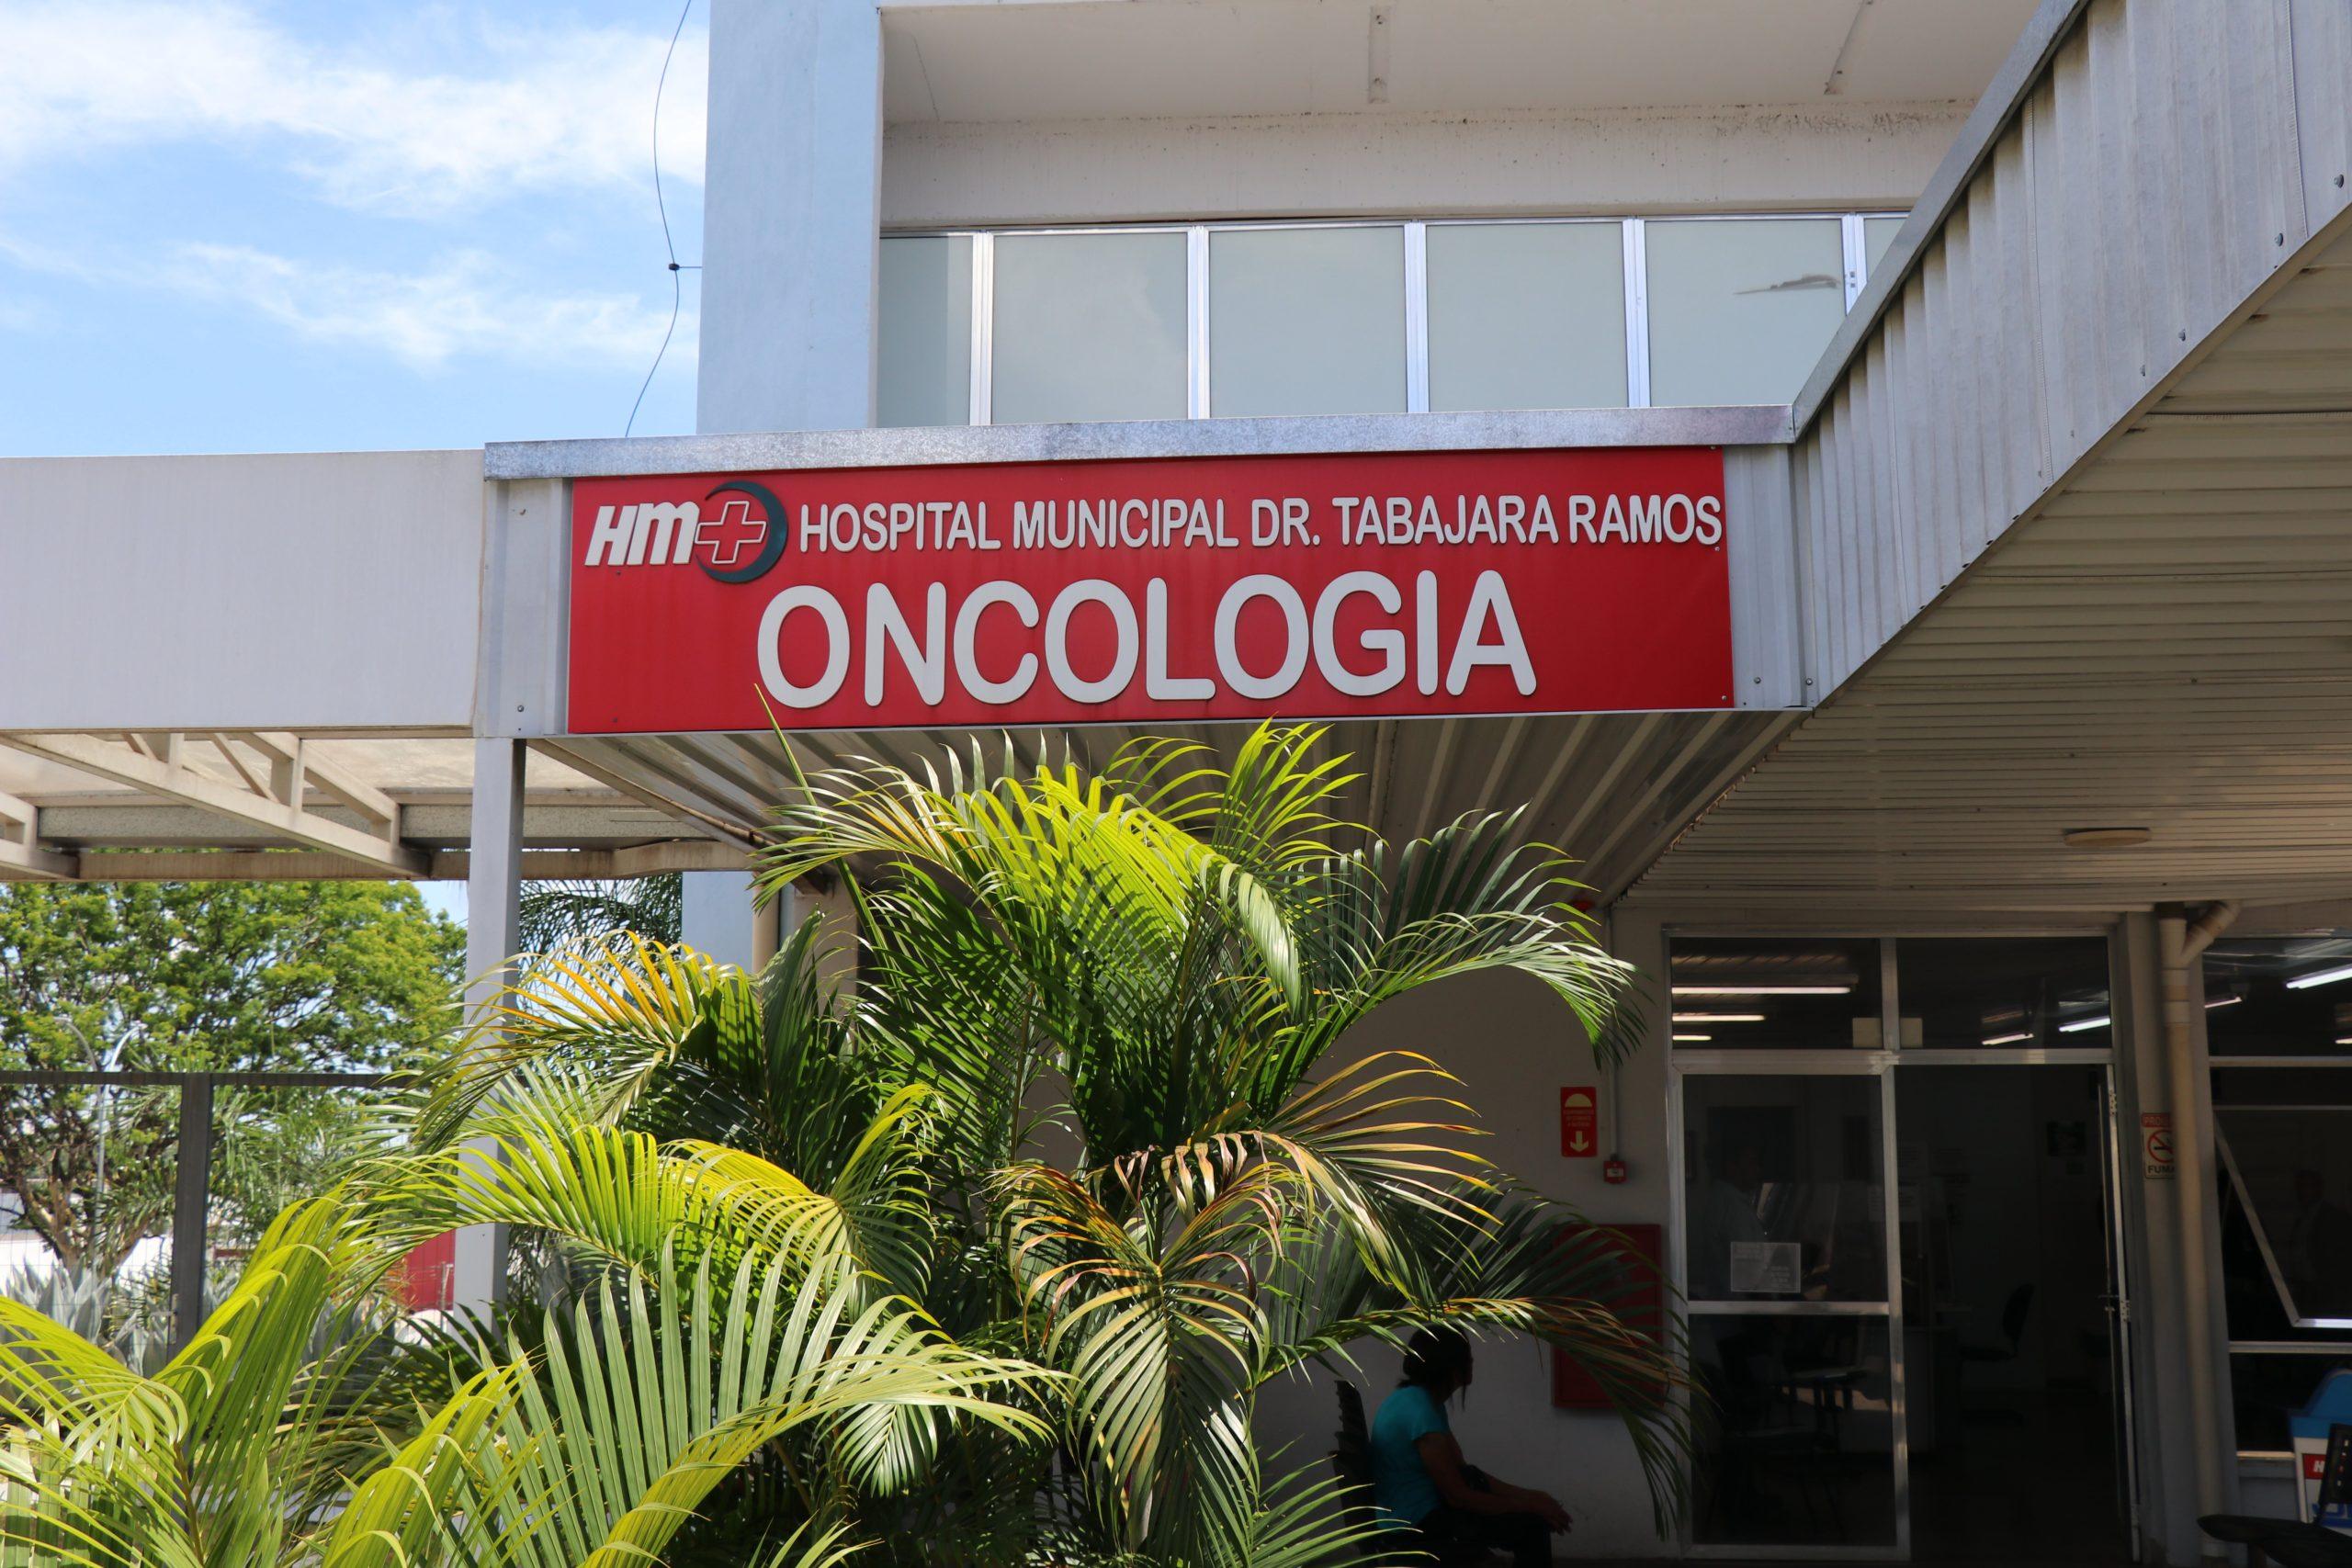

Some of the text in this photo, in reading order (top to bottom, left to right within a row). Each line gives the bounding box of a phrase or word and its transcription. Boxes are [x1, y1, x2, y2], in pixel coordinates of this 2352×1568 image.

[800, 493, 1723, 552] HOSPITAL MUNICIPAL DR. TABAJARA RAMOS
[757, 570, 1537, 709] ONCOLOGIA
